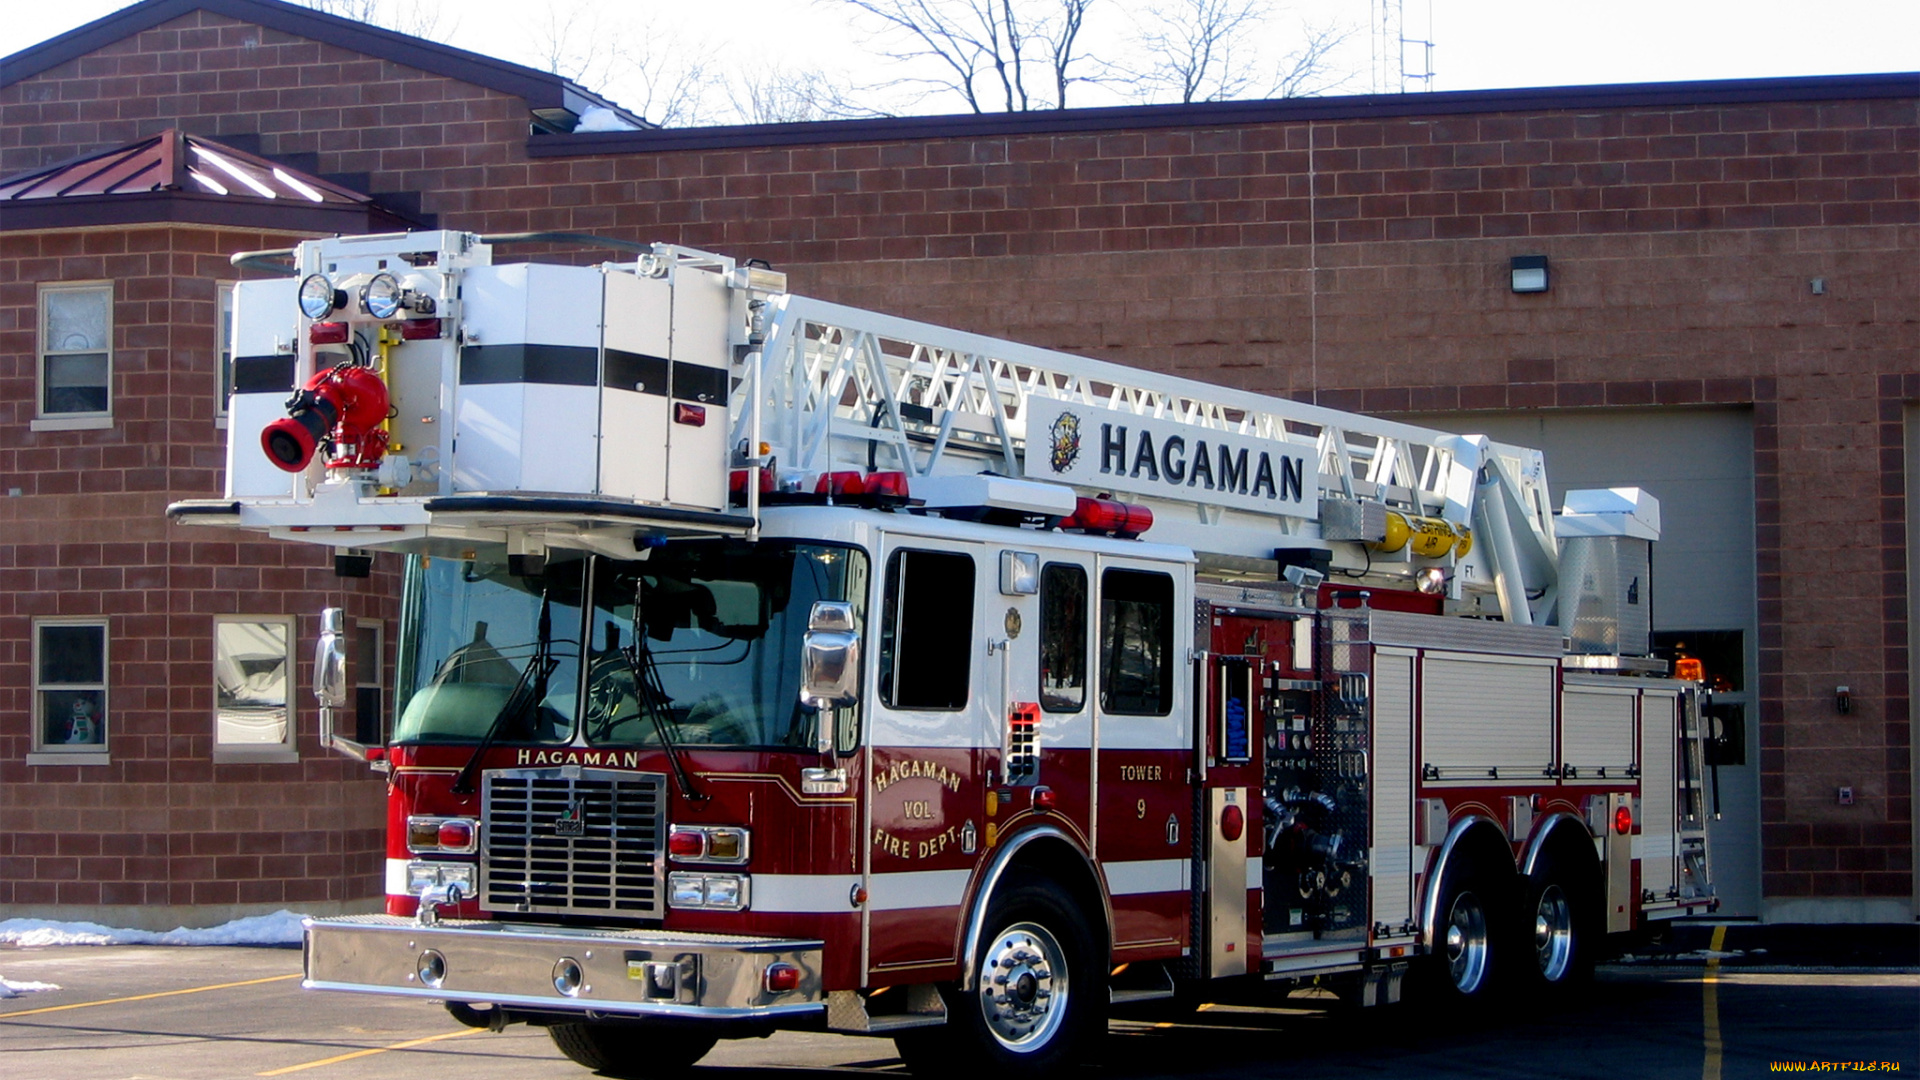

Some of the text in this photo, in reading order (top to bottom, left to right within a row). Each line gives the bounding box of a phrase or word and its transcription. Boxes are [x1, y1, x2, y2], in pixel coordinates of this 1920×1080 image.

[1100, 423, 1303, 503] HAGAMAN
[1423, 536, 1438, 549] AIR
[517, 749, 638, 768] HAGAMAN
[875, 760, 960, 792] HAGAMAN
[1120, 765, 1162, 780] TOWER
[903, 801, 936, 819] VOL.
[1137, 799, 1146, 819] 9
[874, 826, 961, 859] FIRE DEPT.
